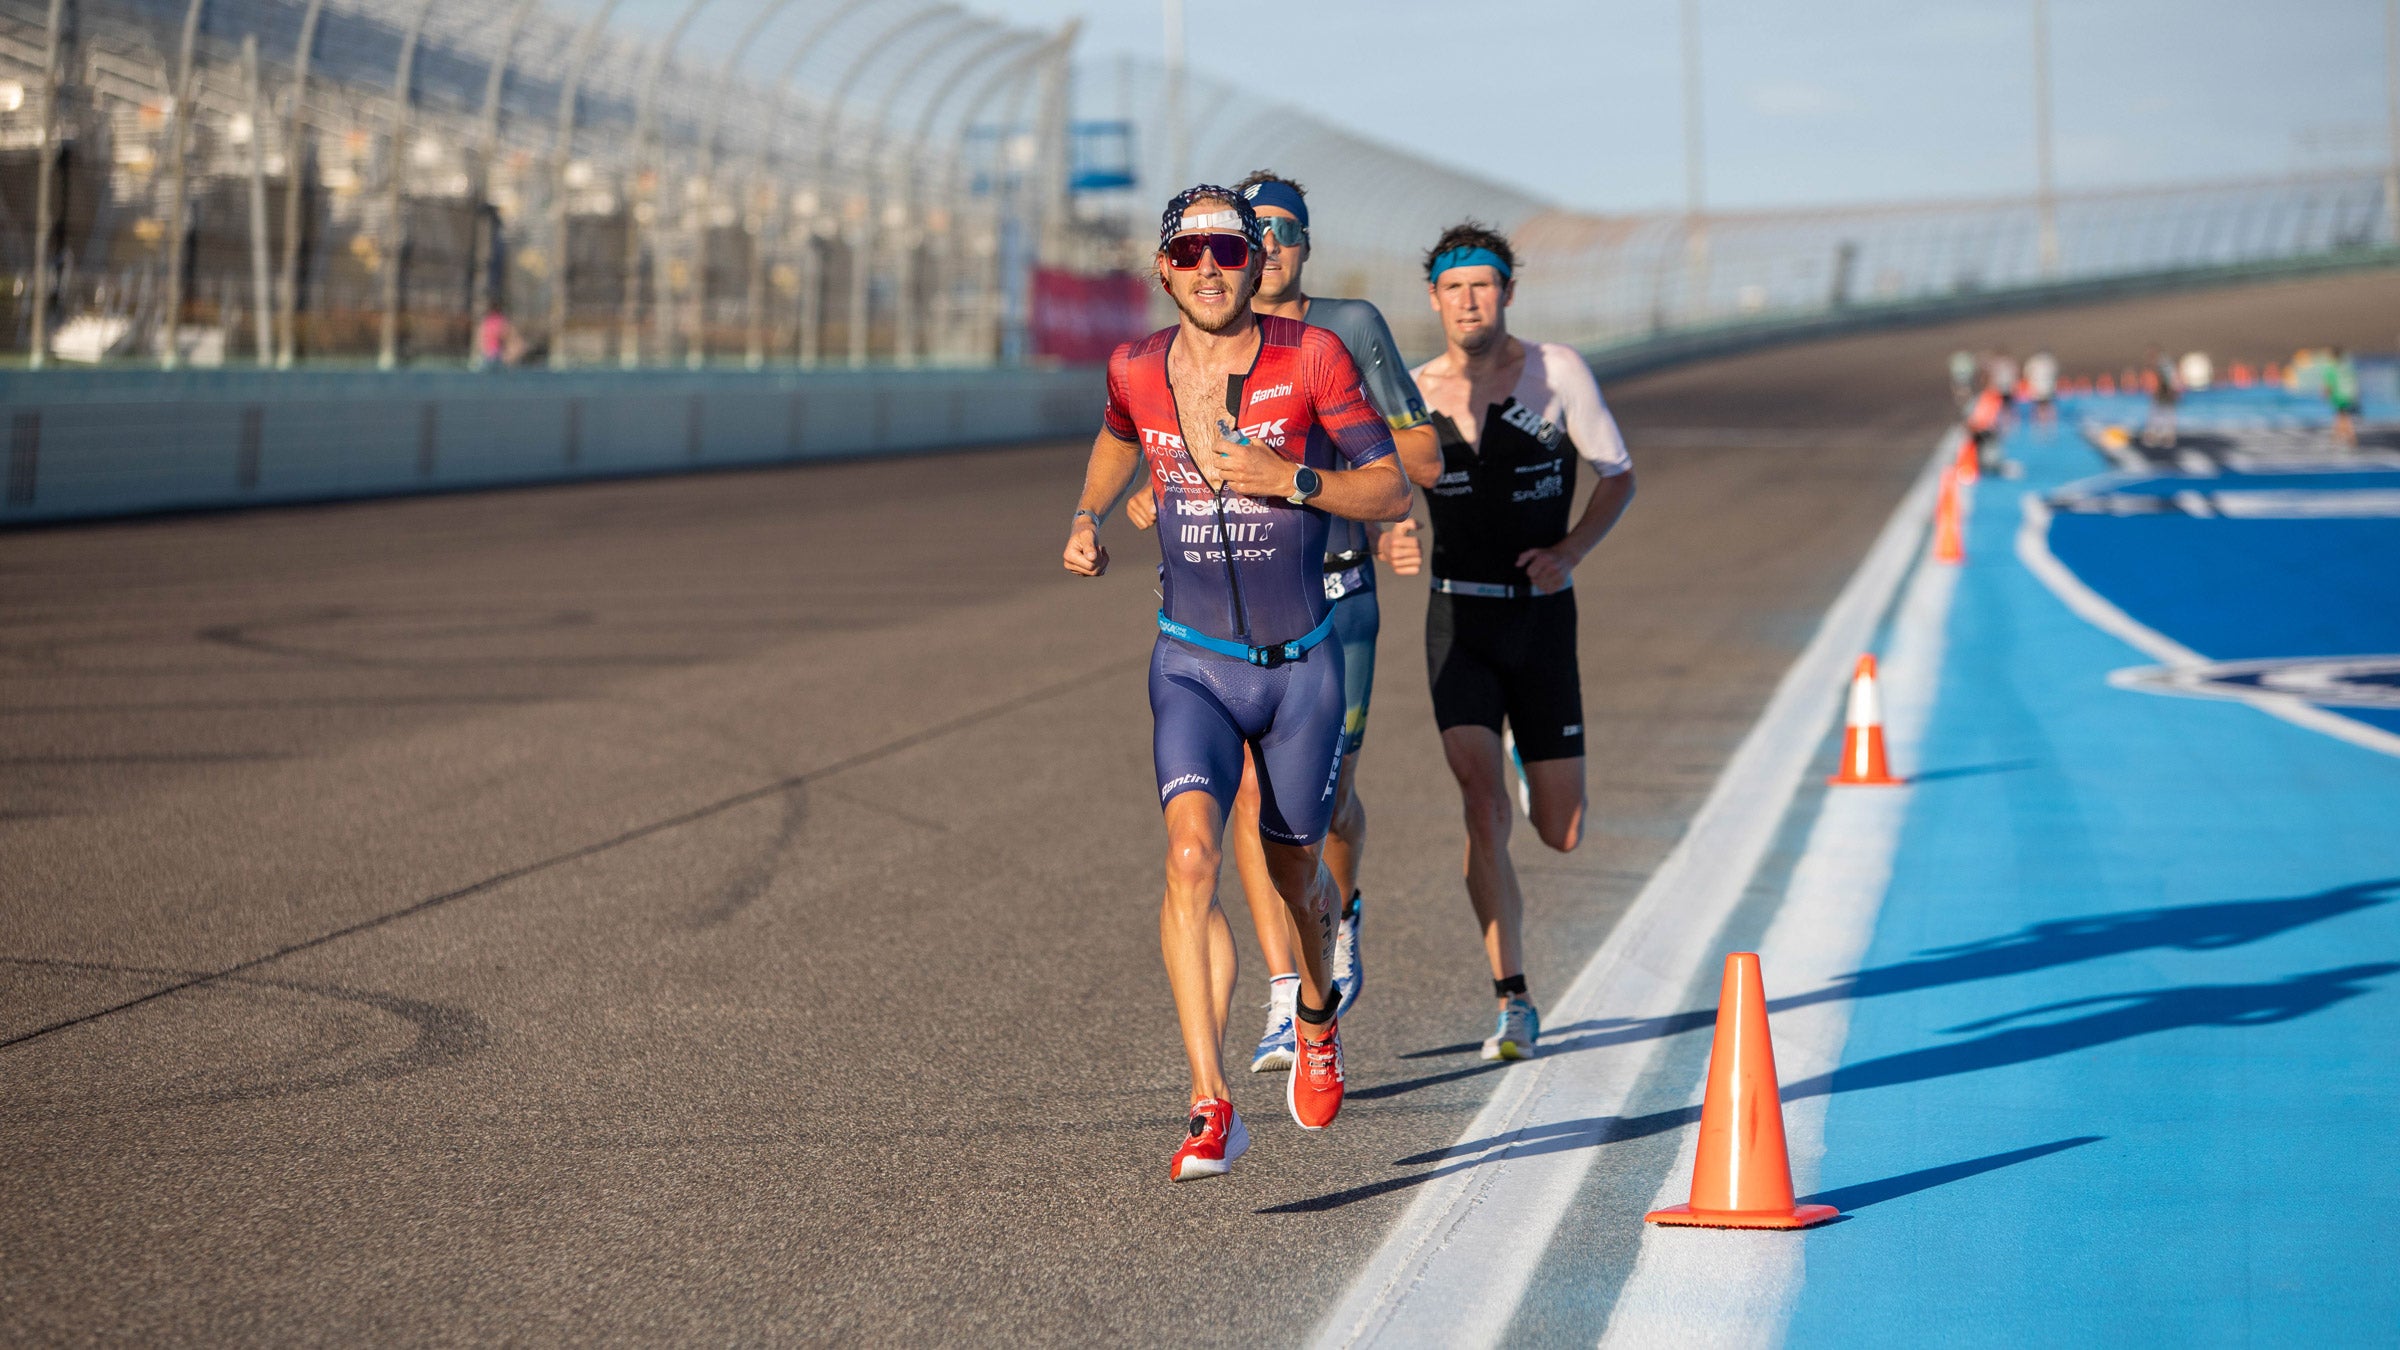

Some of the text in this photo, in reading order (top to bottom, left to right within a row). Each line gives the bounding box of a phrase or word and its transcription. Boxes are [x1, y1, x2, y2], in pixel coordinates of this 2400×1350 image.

[1250, 382, 1293, 406] Santini
[1156, 460, 1203, 485] deb
[1176, 497, 1242, 516] HOKA
[1241, 505, 1271, 515] ONE
[1205, 548, 1277, 559] RUDY
[1162, 773, 1210, 802] Santini
